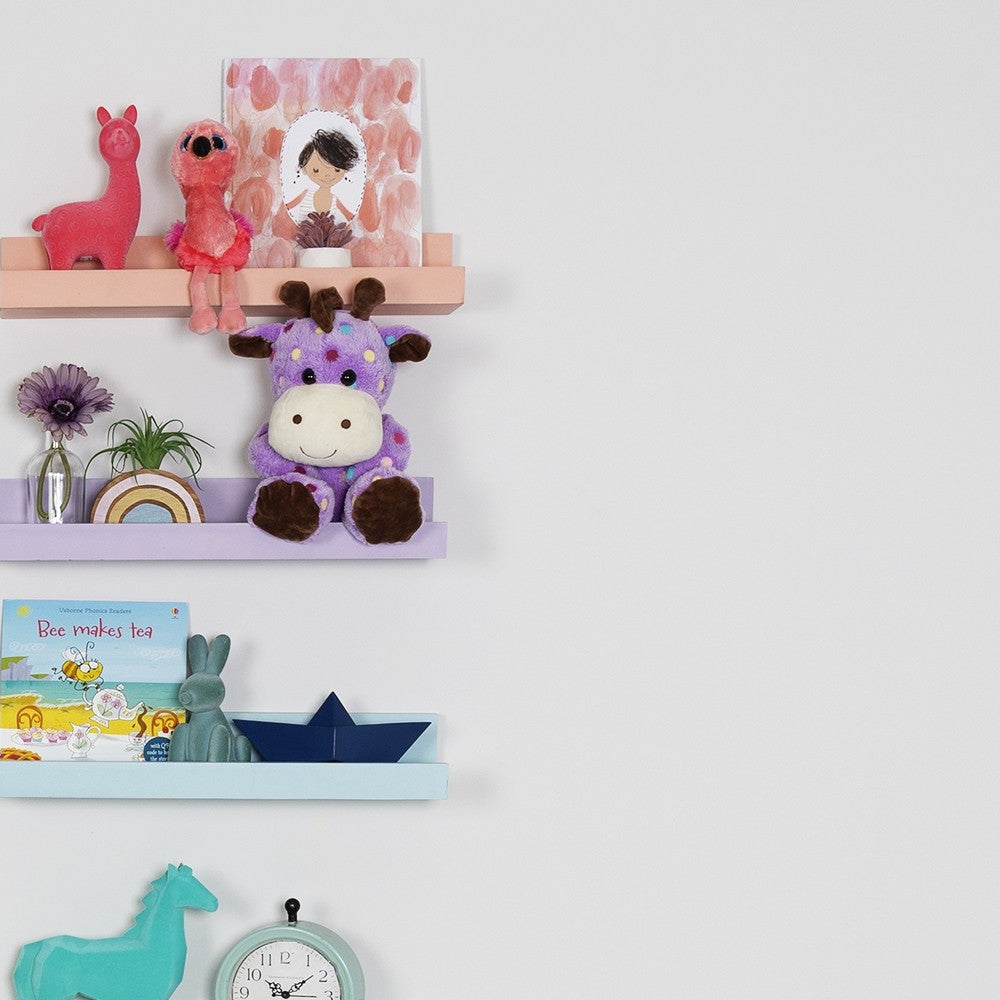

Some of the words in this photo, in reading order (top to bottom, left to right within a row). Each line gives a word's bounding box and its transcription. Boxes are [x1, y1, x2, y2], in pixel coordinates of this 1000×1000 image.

[37, 620, 66, 638] Bee
[73, 618, 123, 638] makes
[129, 622, 153, 638] tea
[260, 953, 272, 966] 11
[280, 951, 291, 965] 12
[306, 954, 310, 967] 1
[247, 968, 262, 982] 10
[318, 970, 328, 983] 2
[239, 986, 249, 999] 9
